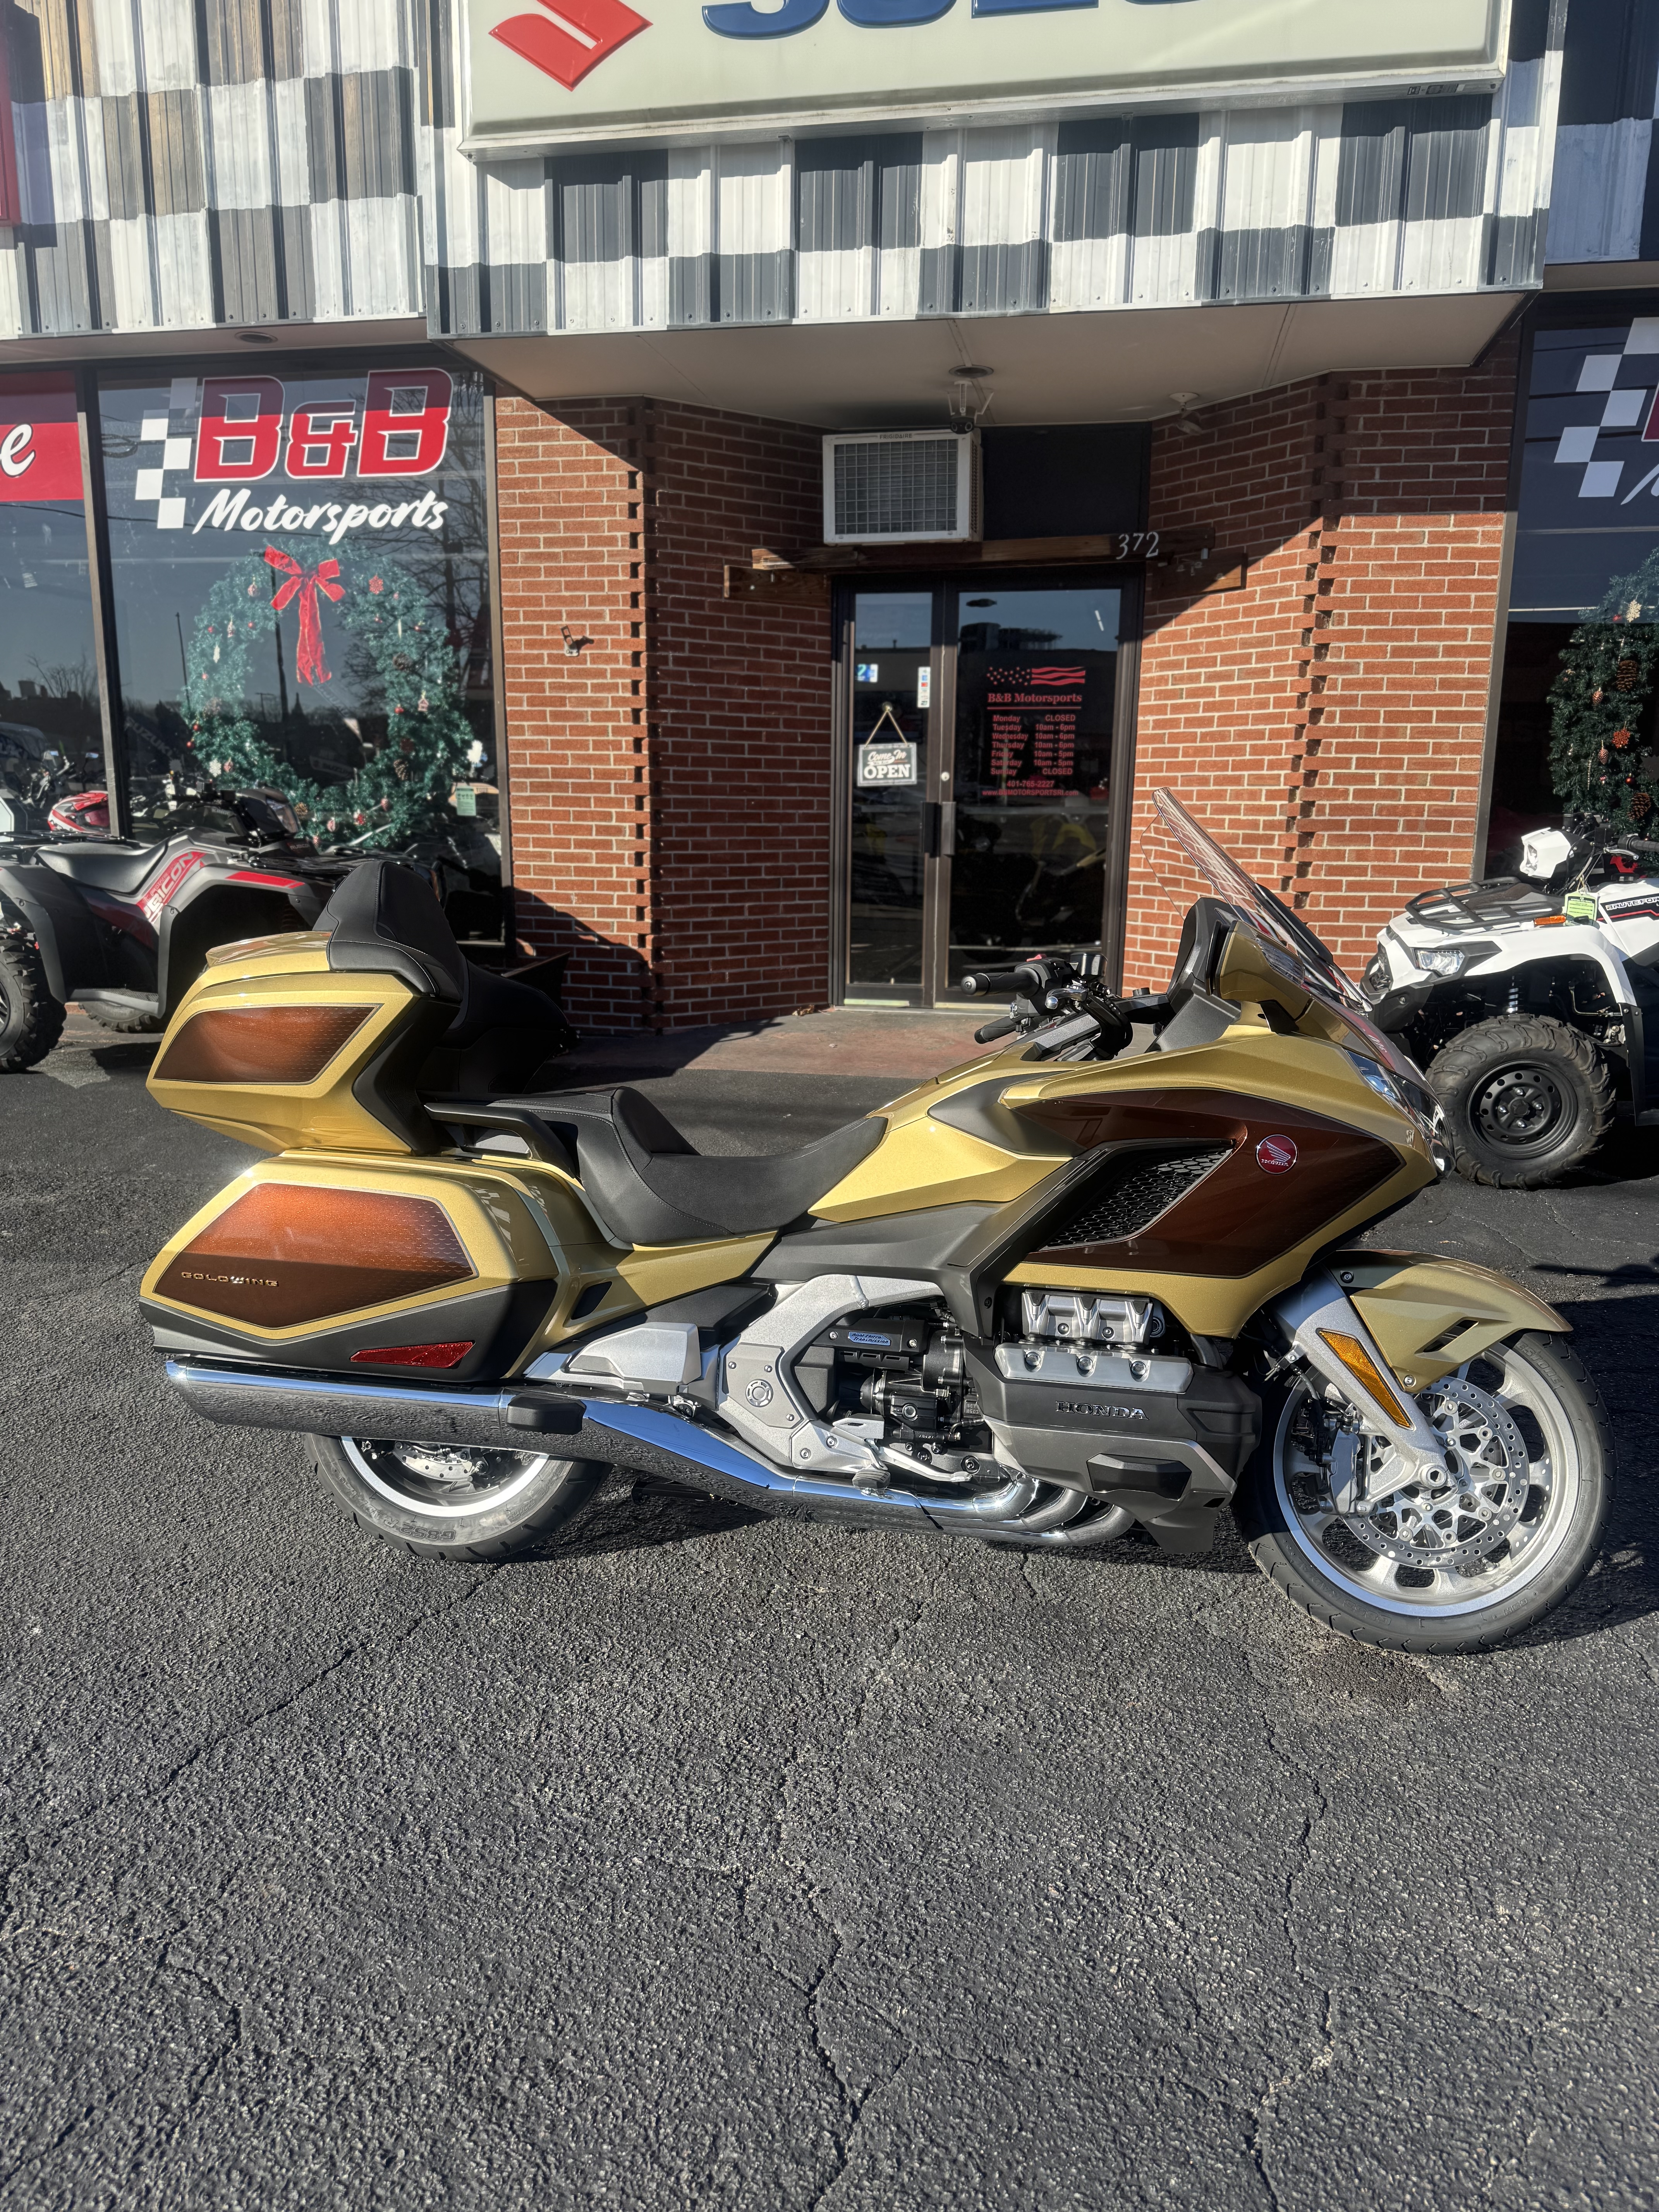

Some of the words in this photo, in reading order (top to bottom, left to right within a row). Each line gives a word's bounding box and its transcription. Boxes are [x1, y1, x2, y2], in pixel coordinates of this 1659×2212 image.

[194, 367, 454, 482] B&B
[192, 488, 449, 544] Motorsports
[1116, 532, 1159, 559] 372
[988, 693, 1012, 702] B&B
[1014, 693, 1082, 704] Motorsports
[868, 751, 892, 762] Come
[893, 749, 907, 759] In
[864, 764, 911, 779] OPEN
[1055, 1400, 1150, 1420] HONDA
[400, 1522, 456, 1541] G852
